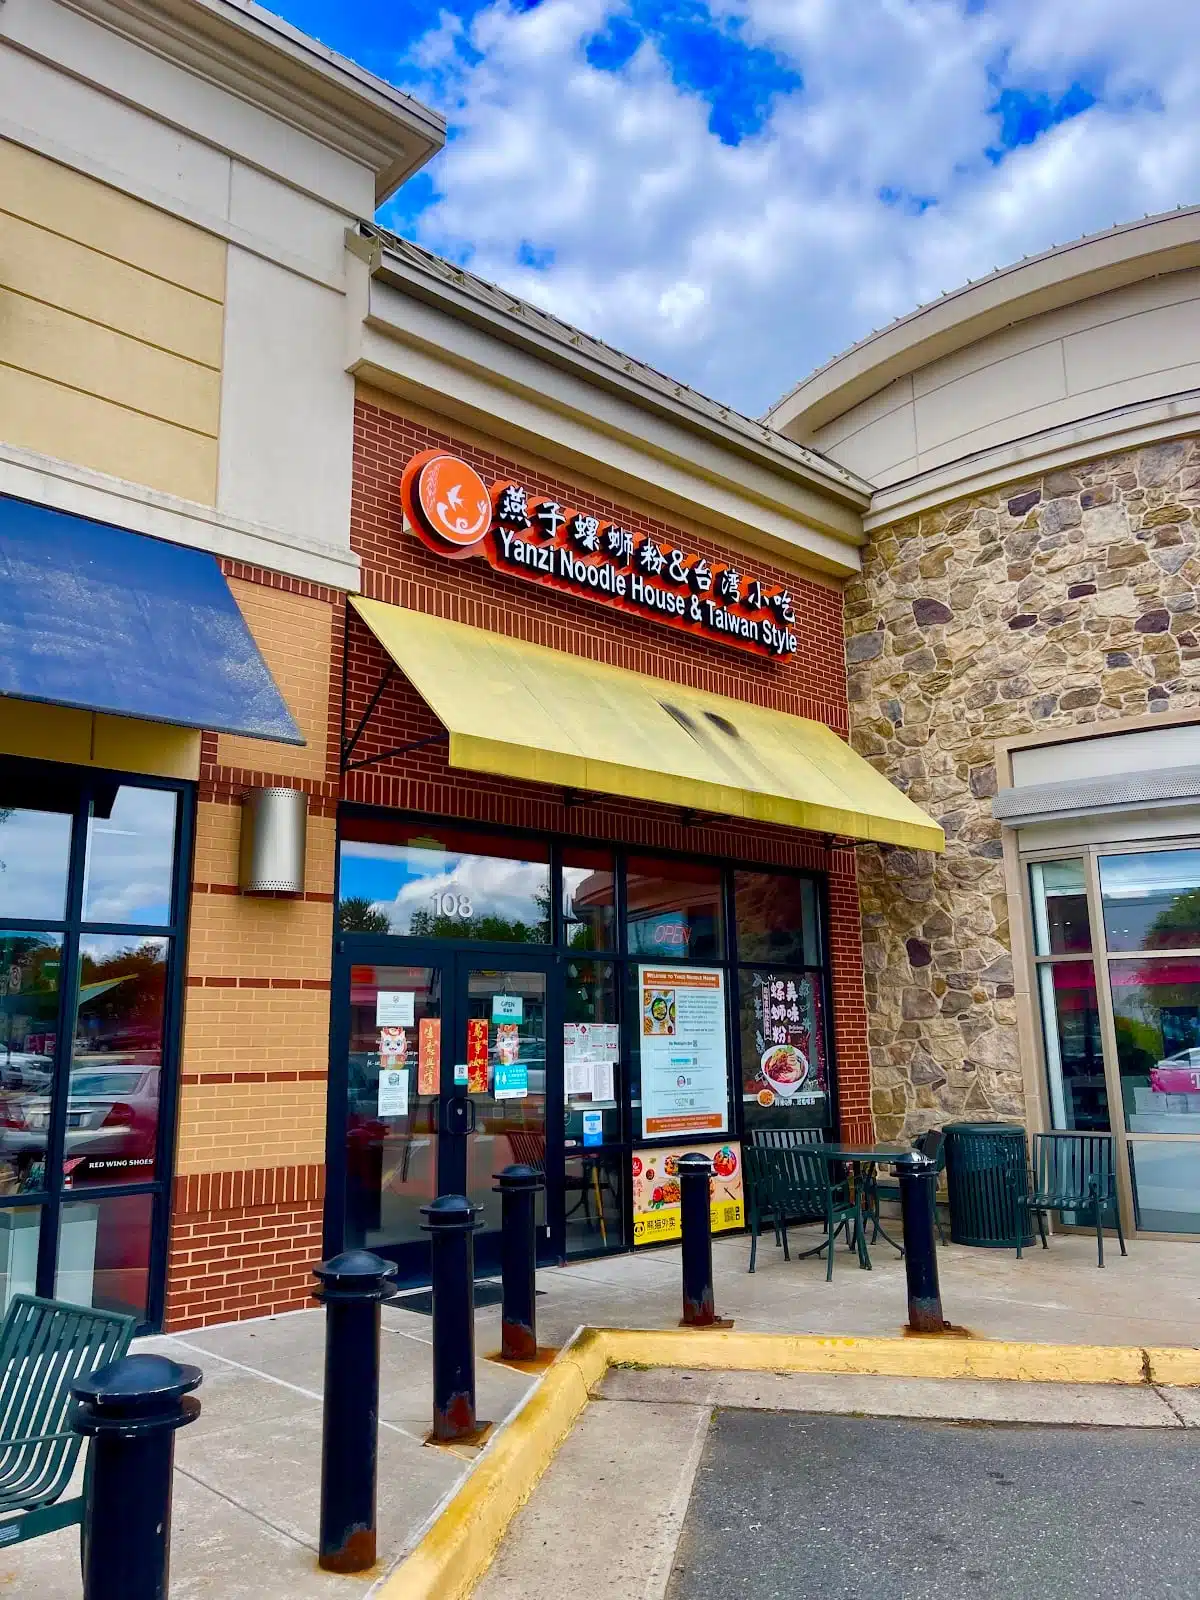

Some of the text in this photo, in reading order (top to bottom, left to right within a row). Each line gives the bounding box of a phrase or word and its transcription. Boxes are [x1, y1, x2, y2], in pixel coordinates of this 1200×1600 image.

[499, 526, 798, 655] Yanzi Noodle House & Taiwan Style
[431, 892, 474, 918] 108
[654, 925, 692, 945] OPEN
[786, 980, 799, 1023] 美味
[88, 1158, 154, 1169] RED WING SHOES
